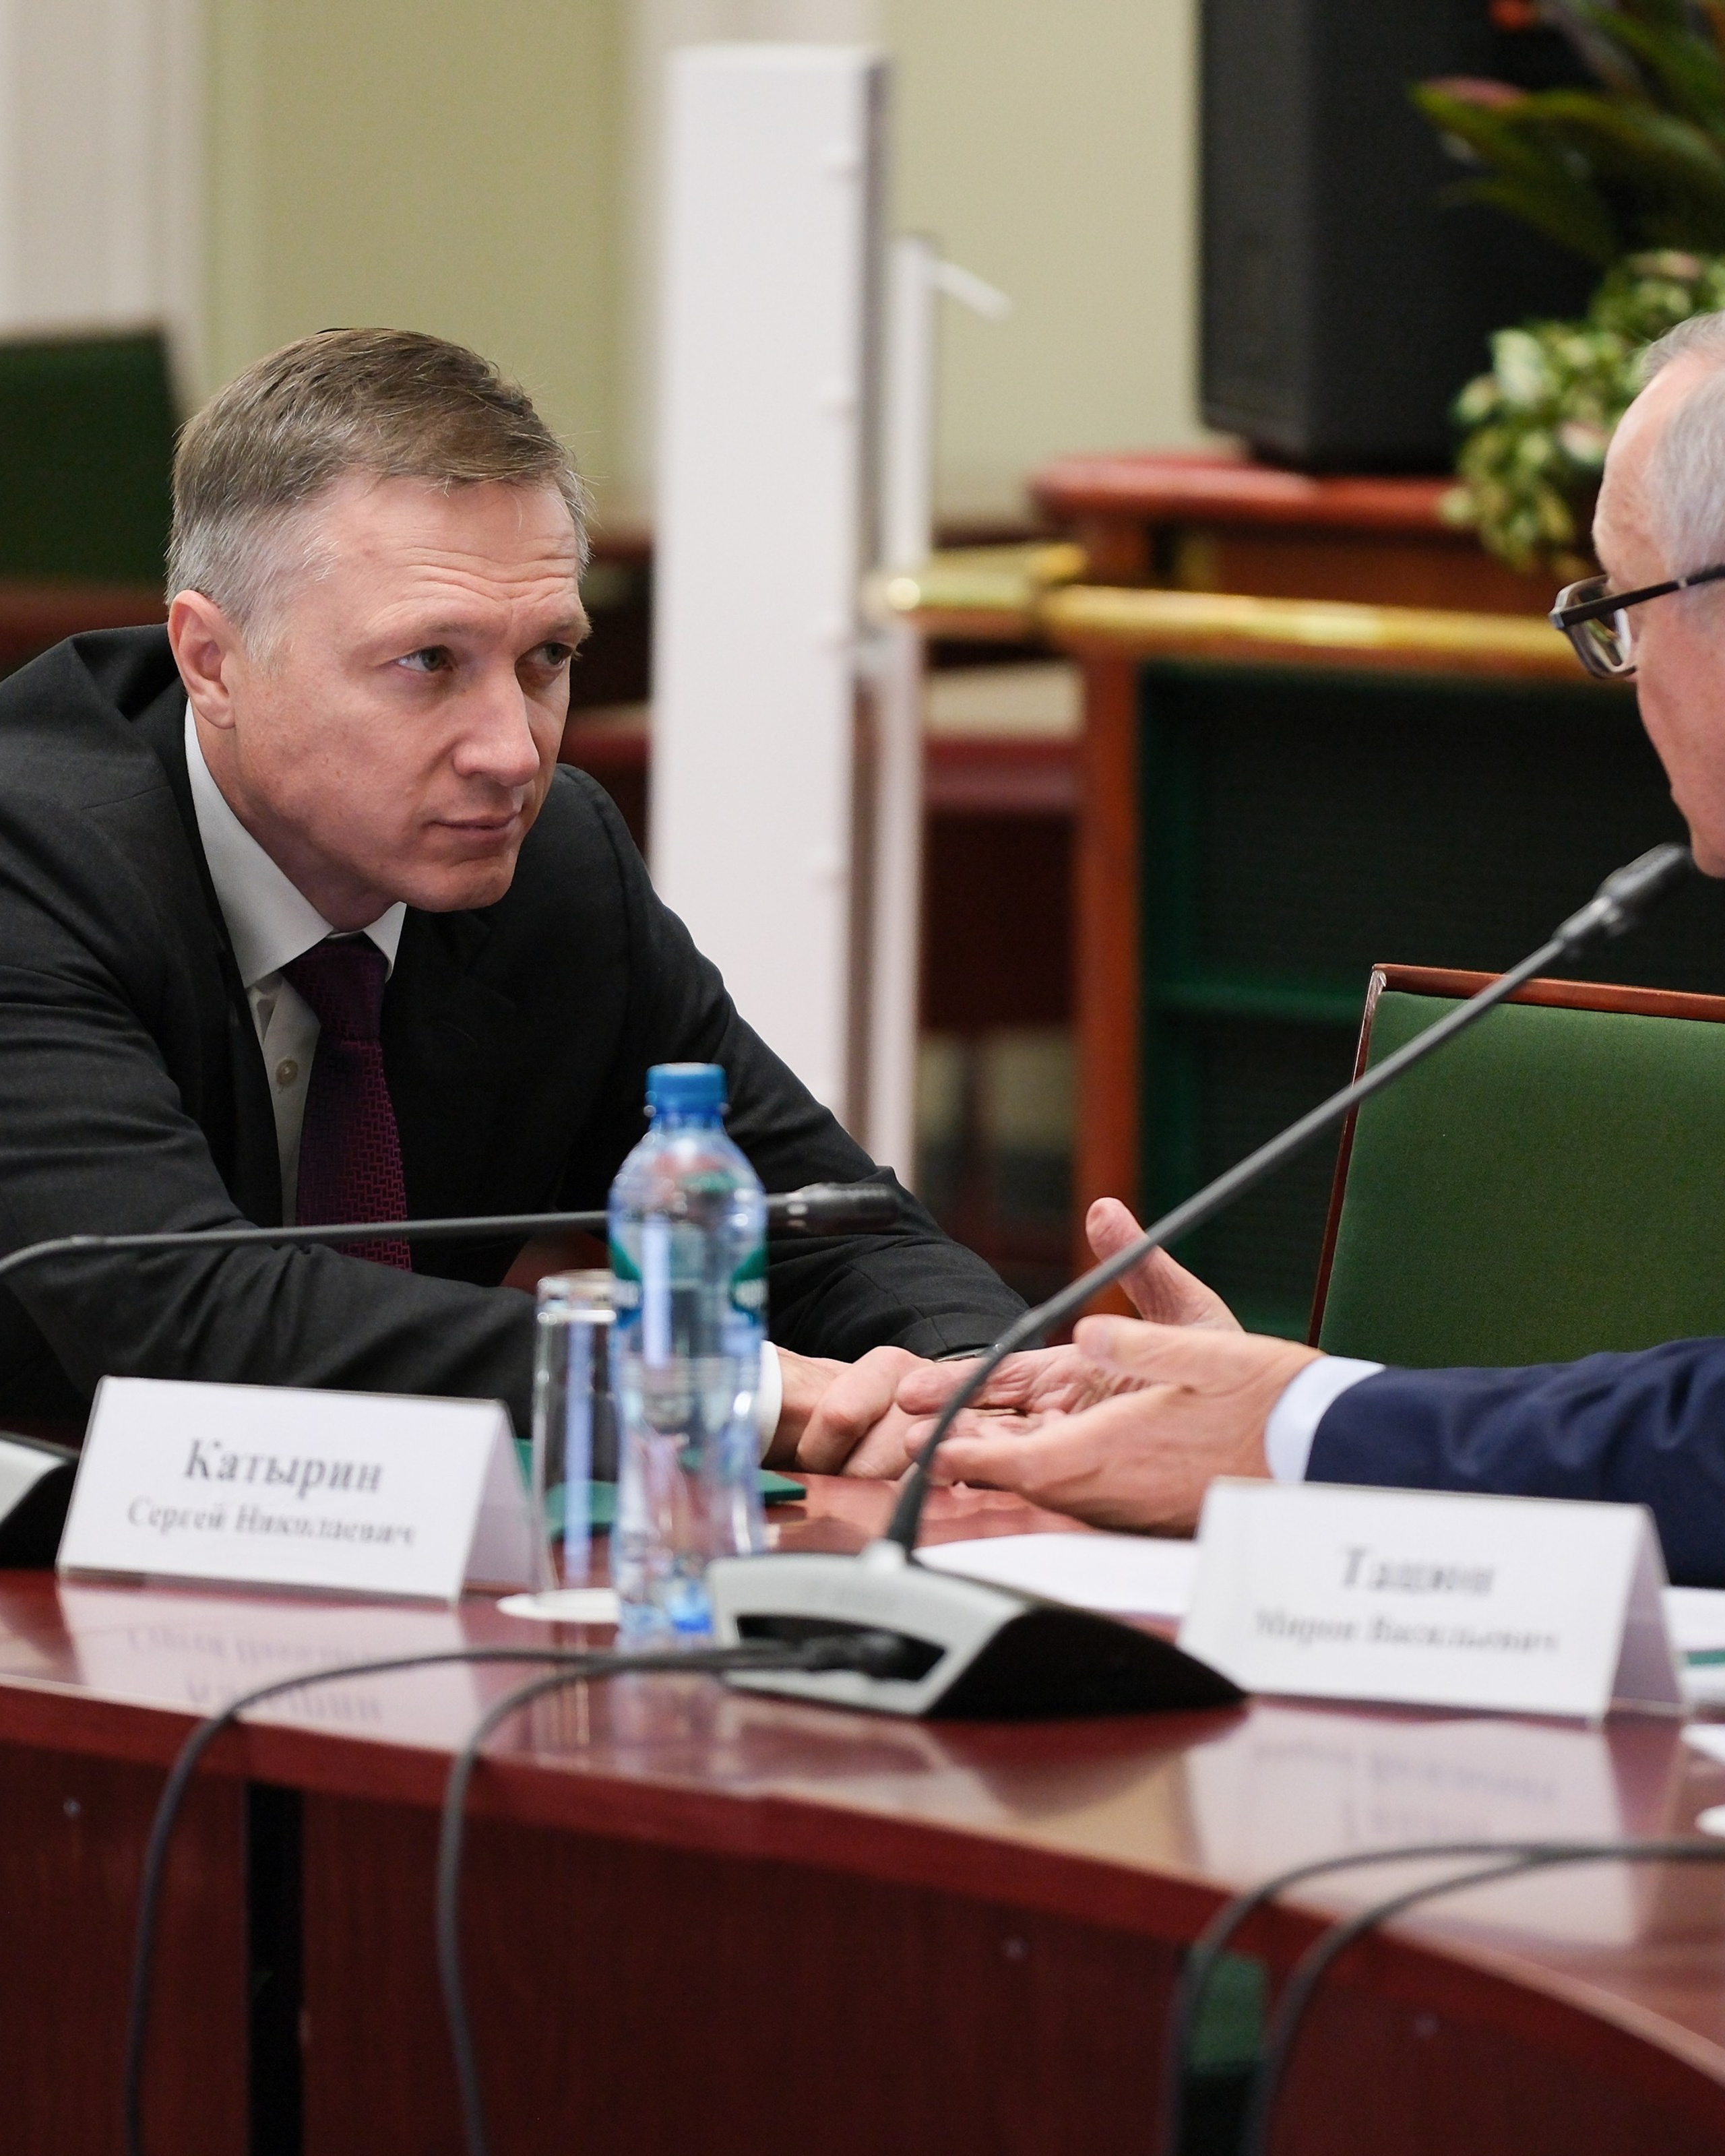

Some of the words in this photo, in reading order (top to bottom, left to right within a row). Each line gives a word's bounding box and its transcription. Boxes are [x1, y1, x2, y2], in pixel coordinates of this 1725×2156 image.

[185, 1438, 382, 1499] Катырин
[127, 1496, 226, 1536] Сергей
[235, 1503, 414, 1545] Николаевич
